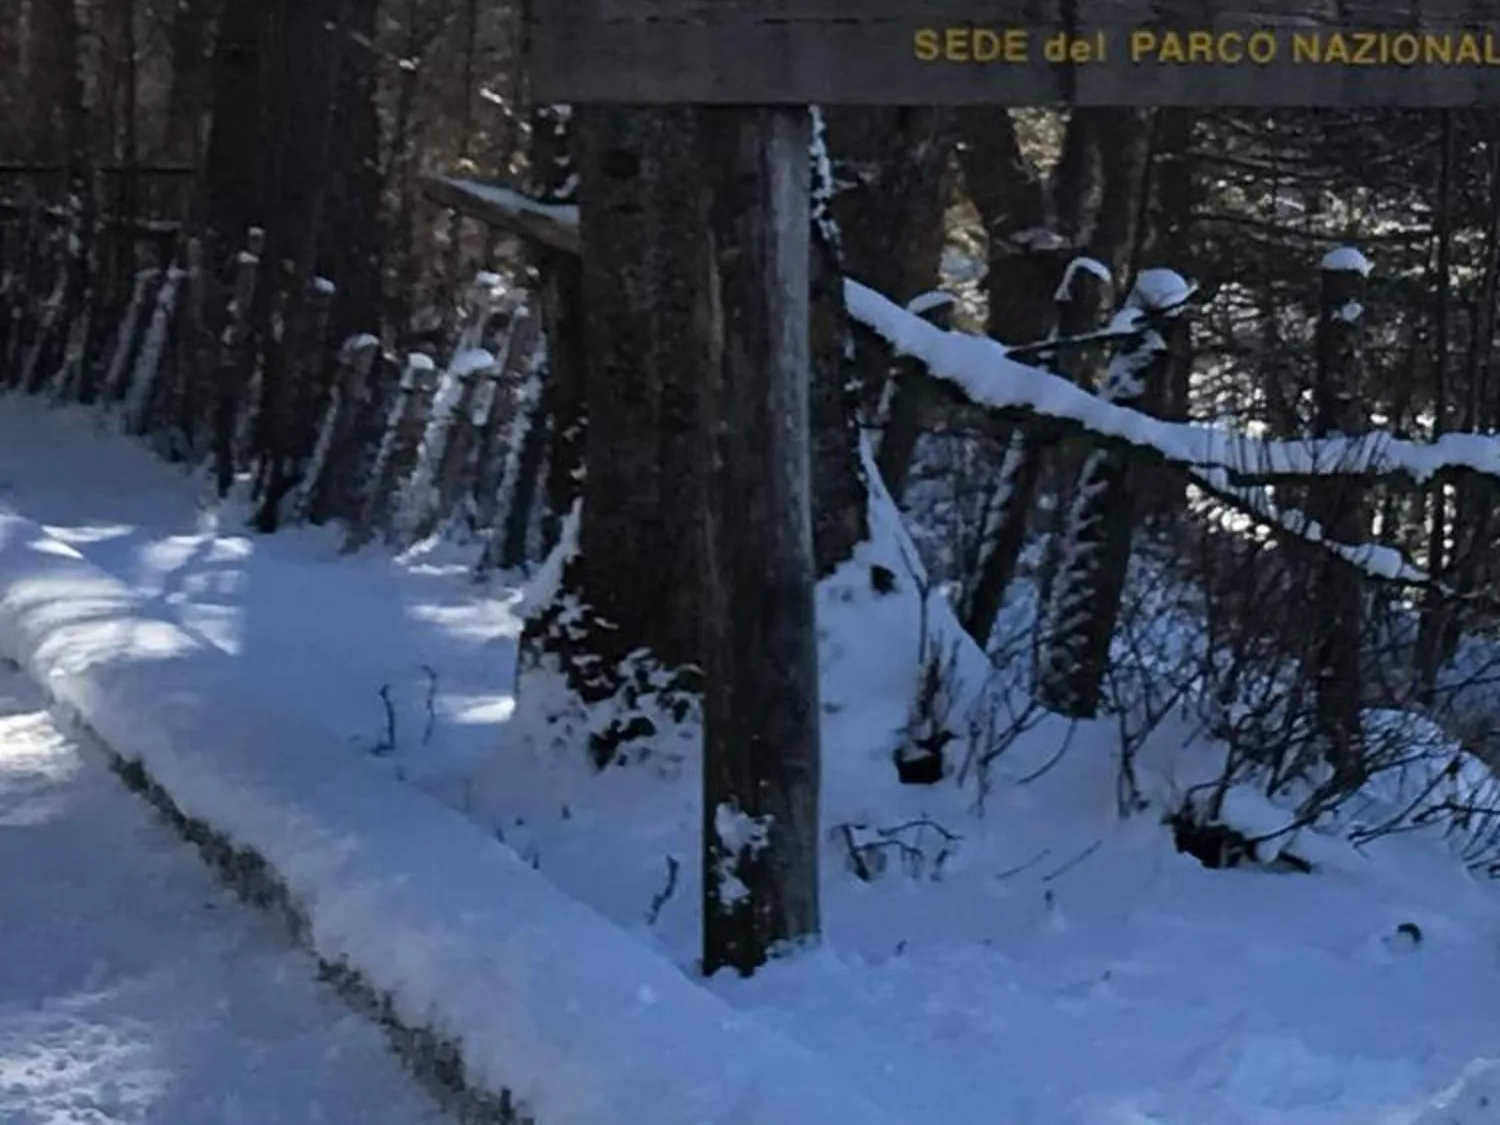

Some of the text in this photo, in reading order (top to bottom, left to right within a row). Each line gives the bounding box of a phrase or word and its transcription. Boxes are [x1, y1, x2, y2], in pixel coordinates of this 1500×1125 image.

[913, 27, 1030, 62] SEDE
[1043, 30, 1107, 63] del
[1131, 31, 1278, 64] PARCO
